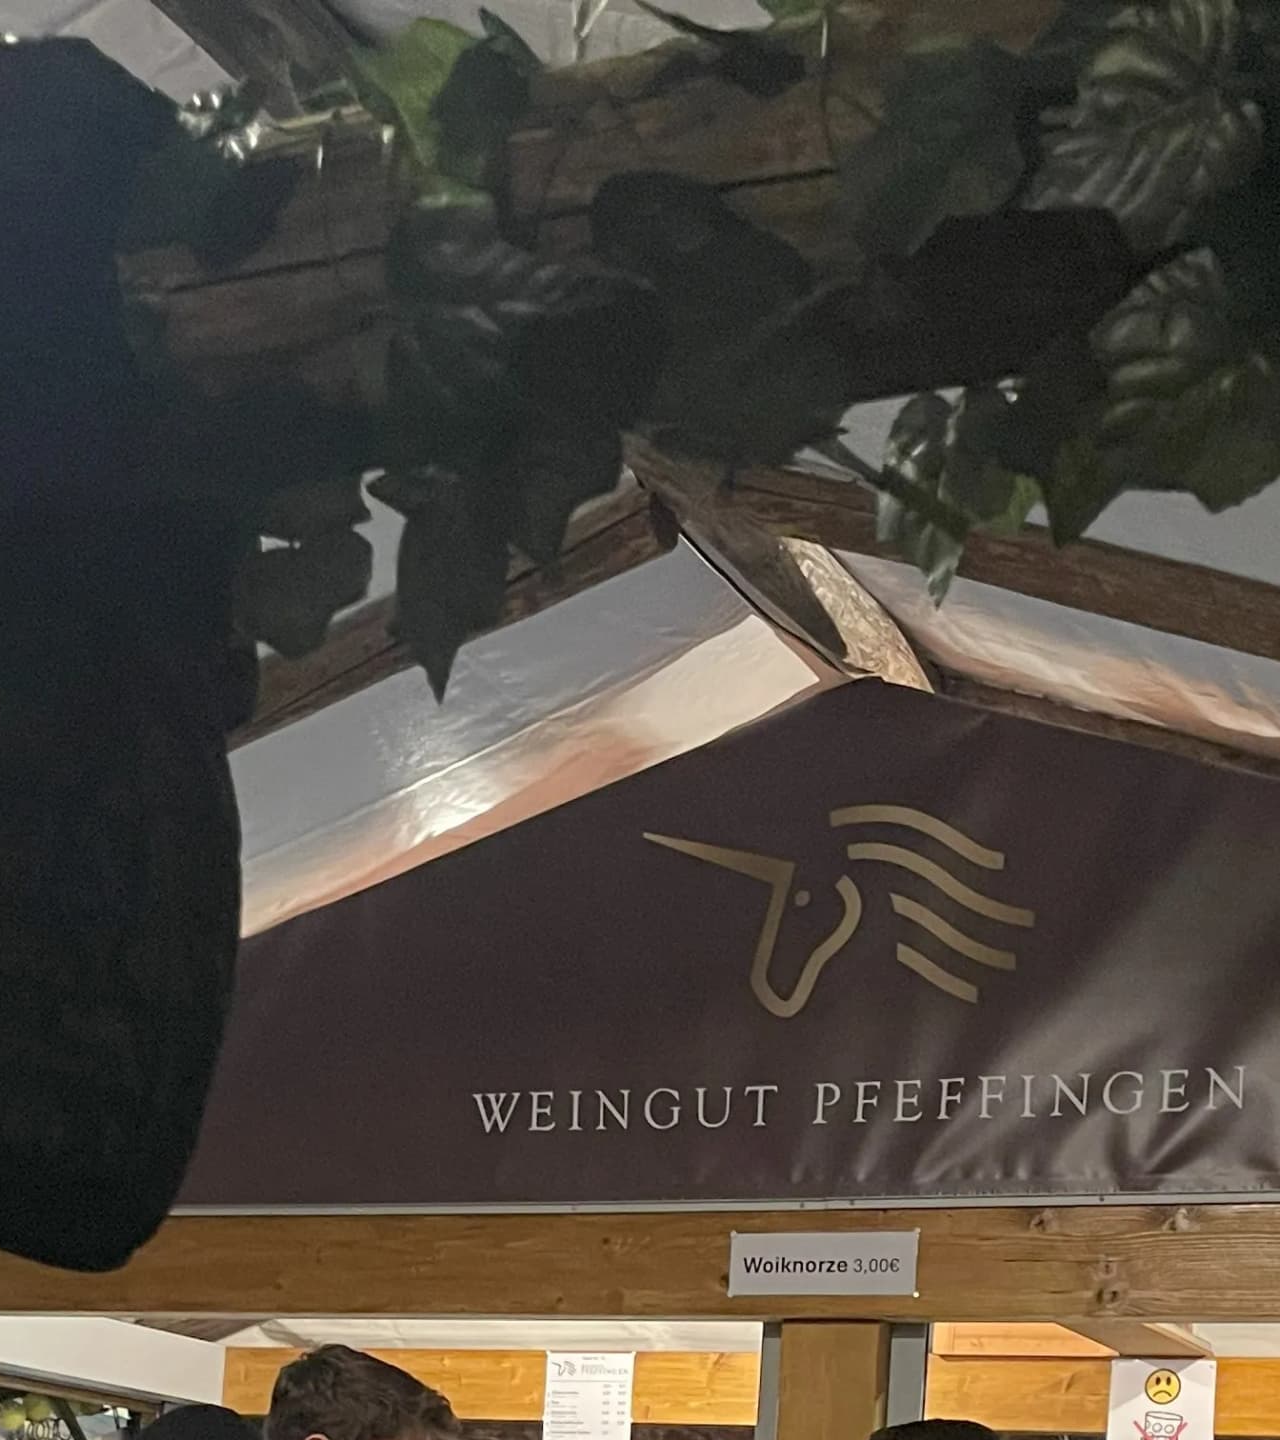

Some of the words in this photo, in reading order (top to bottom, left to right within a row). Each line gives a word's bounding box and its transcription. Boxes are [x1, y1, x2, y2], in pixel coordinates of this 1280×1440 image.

[472, 1084, 779, 1134] WEINGUT
[811, 1064, 1248, 1125] PFEFFINGEN
[743, 1257, 848, 1274] Woiknorze
[852, 1257, 901, 1275] 3,00€
